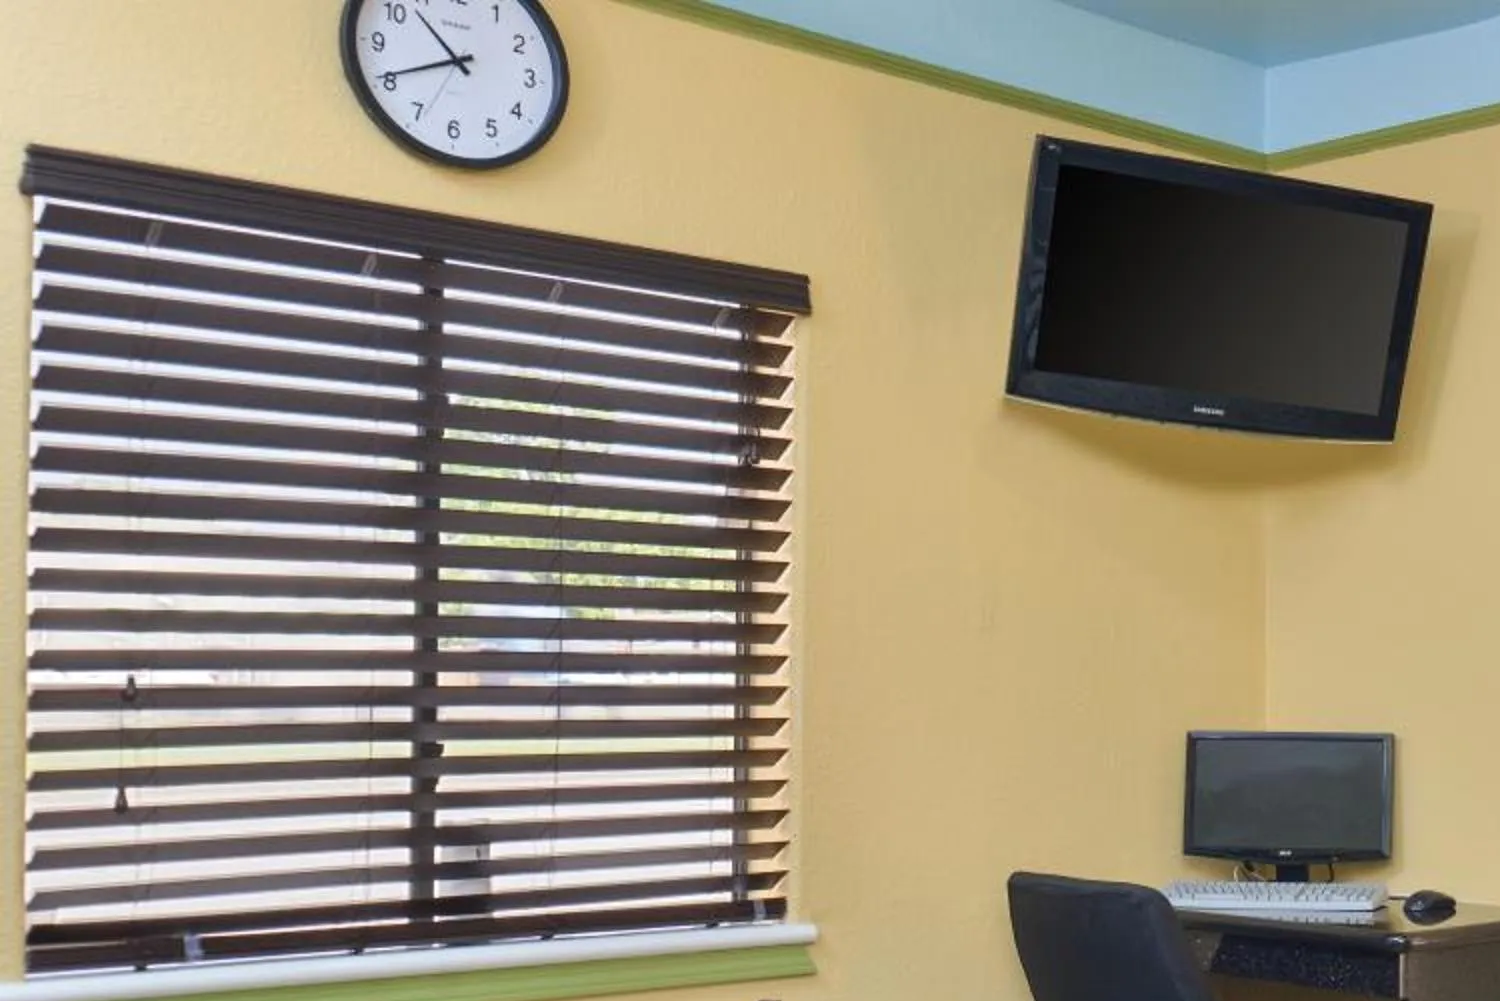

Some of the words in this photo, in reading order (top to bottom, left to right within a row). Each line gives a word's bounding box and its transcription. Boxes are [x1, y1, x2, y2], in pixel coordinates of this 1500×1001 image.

[384, 2, 407, 25] 10
[490, 4, 500, 24] 1
[371, 31, 385, 52] 9
[513, 34, 525, 54] 2
[383, 71, 397, 91] 8
[523, 69, 537, 89] 3
[410, 101, 424, 122] 7
[511, 102, 523, 120] 4
[447, 119, 461, 140] 6
[485, 118, 499, 139] 5
